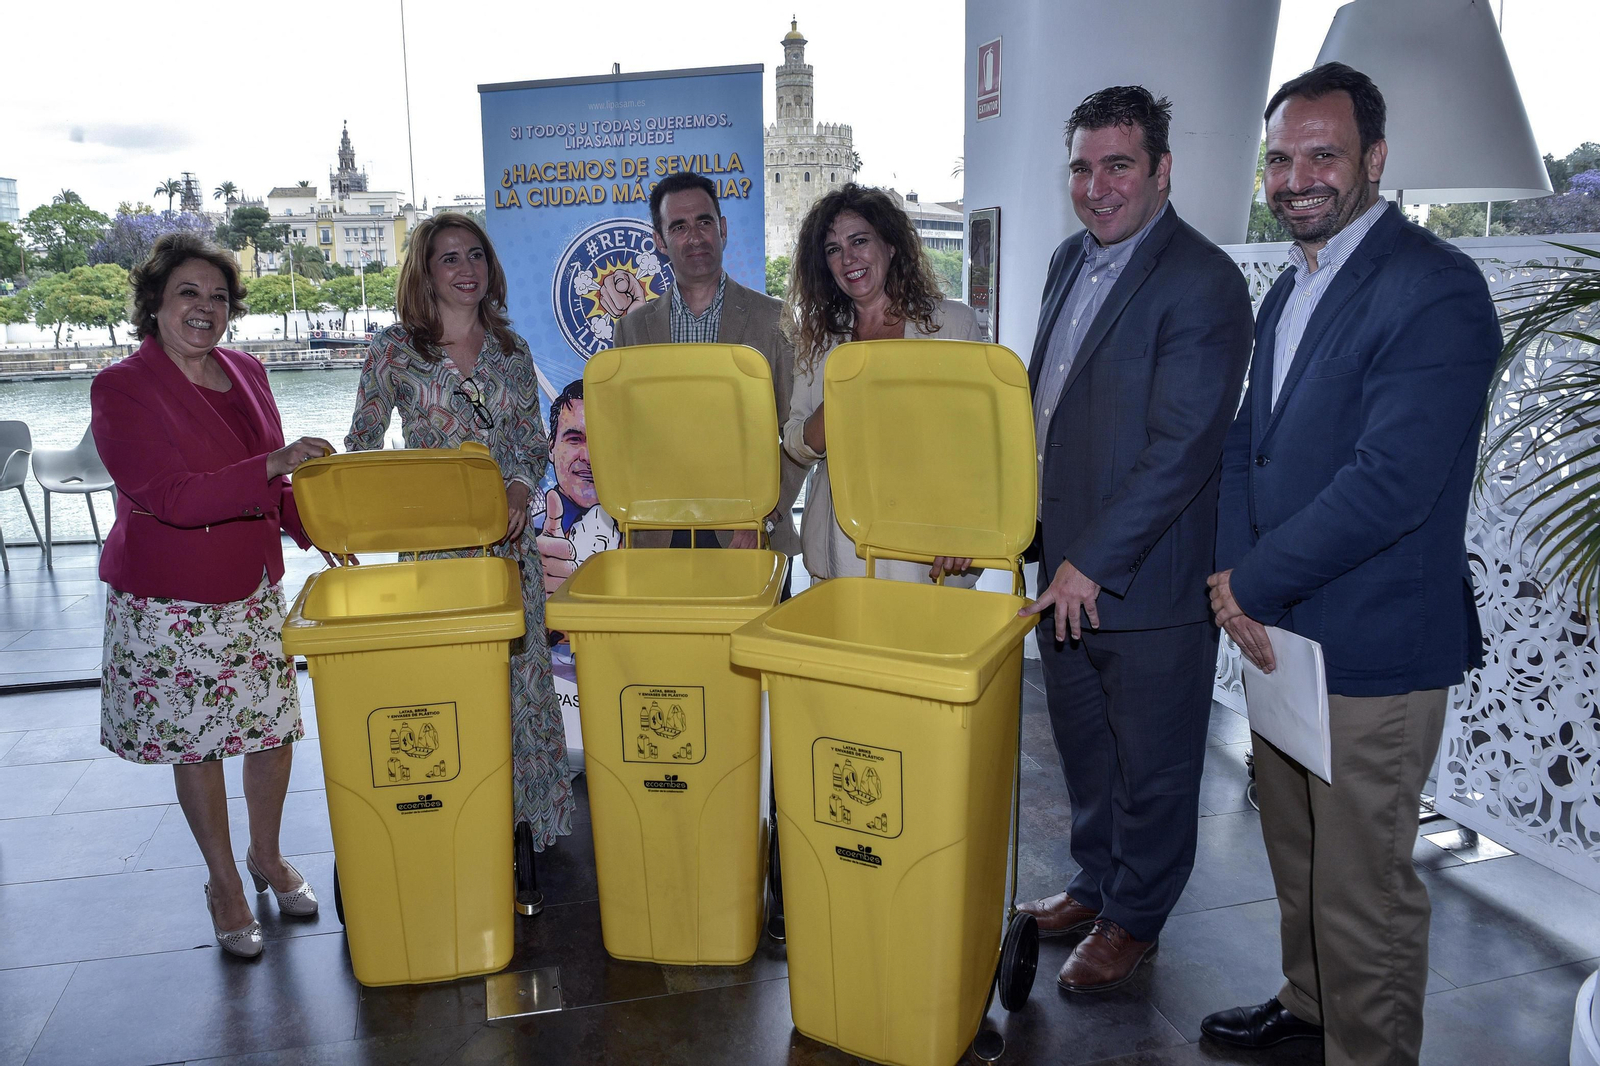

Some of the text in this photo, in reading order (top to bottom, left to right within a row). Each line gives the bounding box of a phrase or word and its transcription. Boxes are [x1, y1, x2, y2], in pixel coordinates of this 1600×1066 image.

[588, 100, 646, 110] www.lipasam.es
[979, 100, 998, 114] EXTINTOR
[510, 113, 733, 140] SI TODOS Y TODAS QUEREMOS,
[565, 130, 674, 150] LIPASAM PUEDE
[501, 152, 744, 188] ¿HACEMOS DE SEVILLA
[495, 188, 521, 208] LA
[527, 185, 606, 207] CIUDAD
[586, 230, 657, 258] #RETO
[578, 328, 609, 353] LIP
[556, 693, 580, 708] PAS
[398, 801, 442, 810] ecoembes
[837, 848, 881, 864] ecoembes
